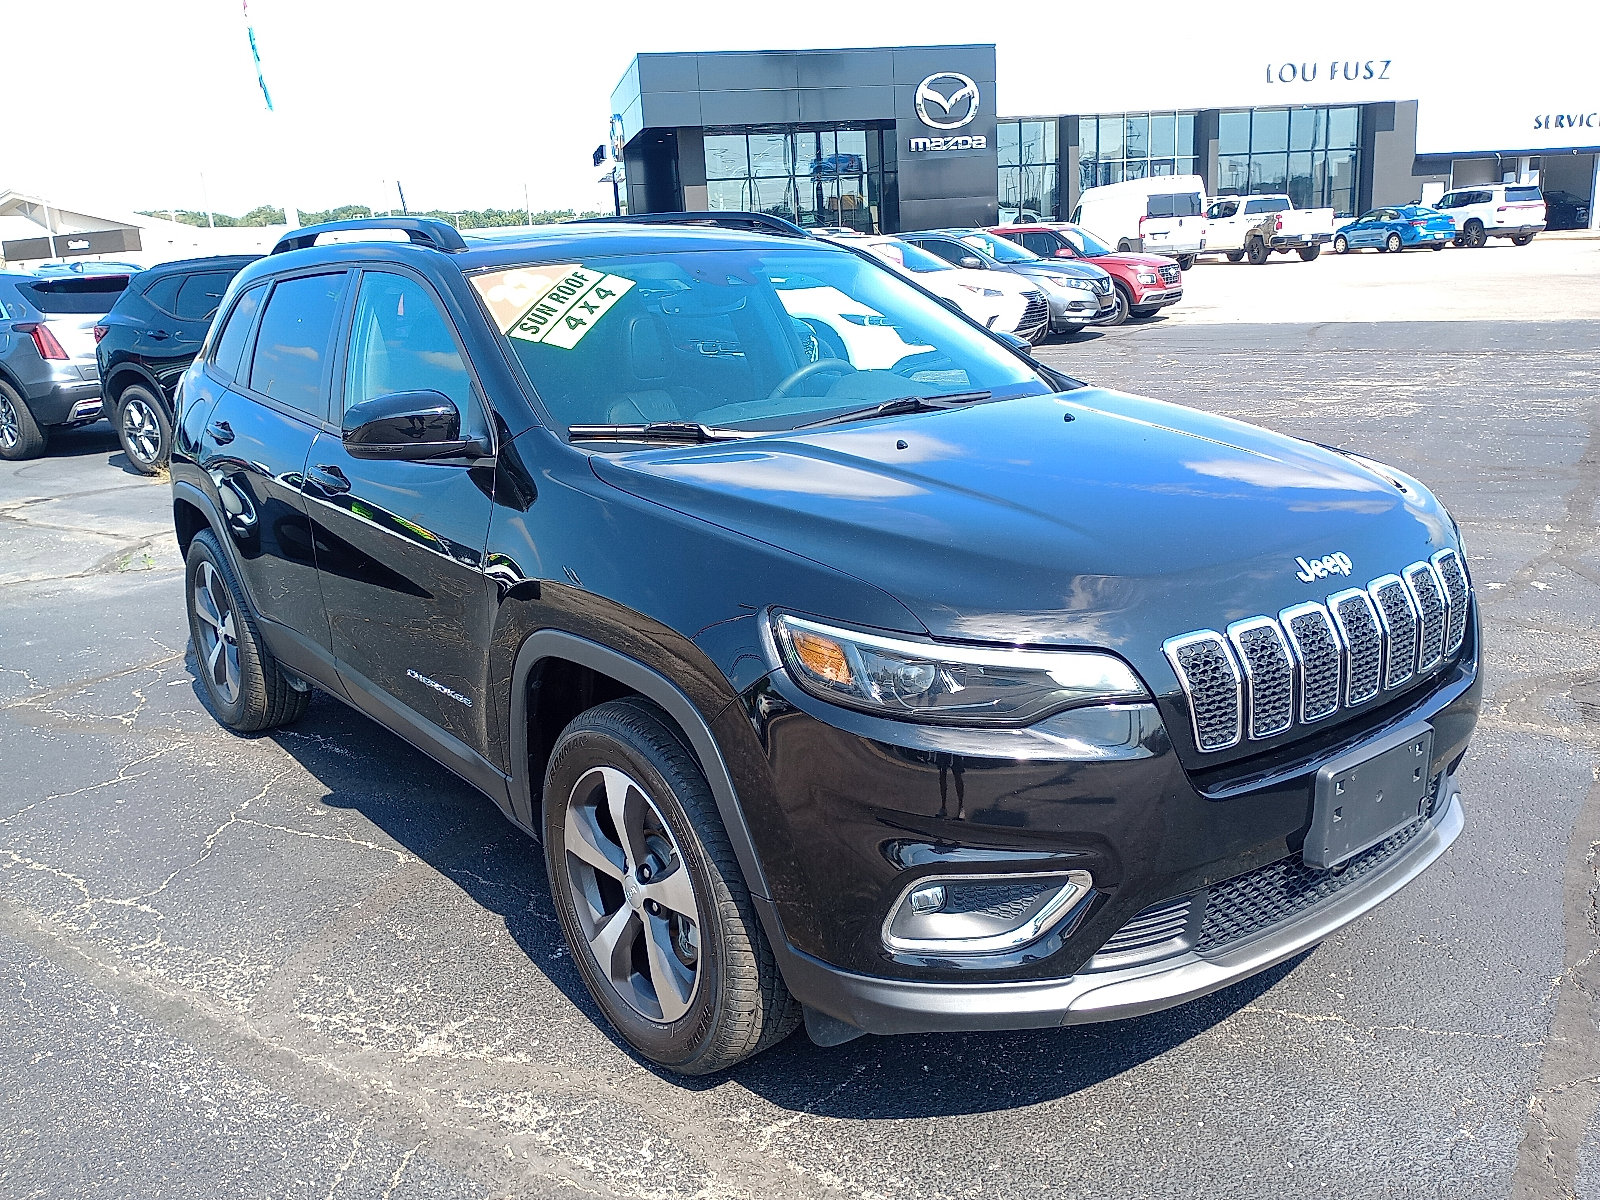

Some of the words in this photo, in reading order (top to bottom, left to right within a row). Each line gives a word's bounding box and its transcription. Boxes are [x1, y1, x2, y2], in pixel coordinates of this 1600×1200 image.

[1266, 62, 1317, 83] LOU
[1329, 60, 1392, 80] FUSZ
[1533, 112, 1600, 130] SERVIC
[519, 303, 559, 335] SUN
[547, 271, 590, 304] ROOF
[565, 315, 587, 331] 4
[595, 287, 617, 300] 4
[1294, 551, 1354, 584] Jeep
[406, 668, 473, 708] CHEROKEE
